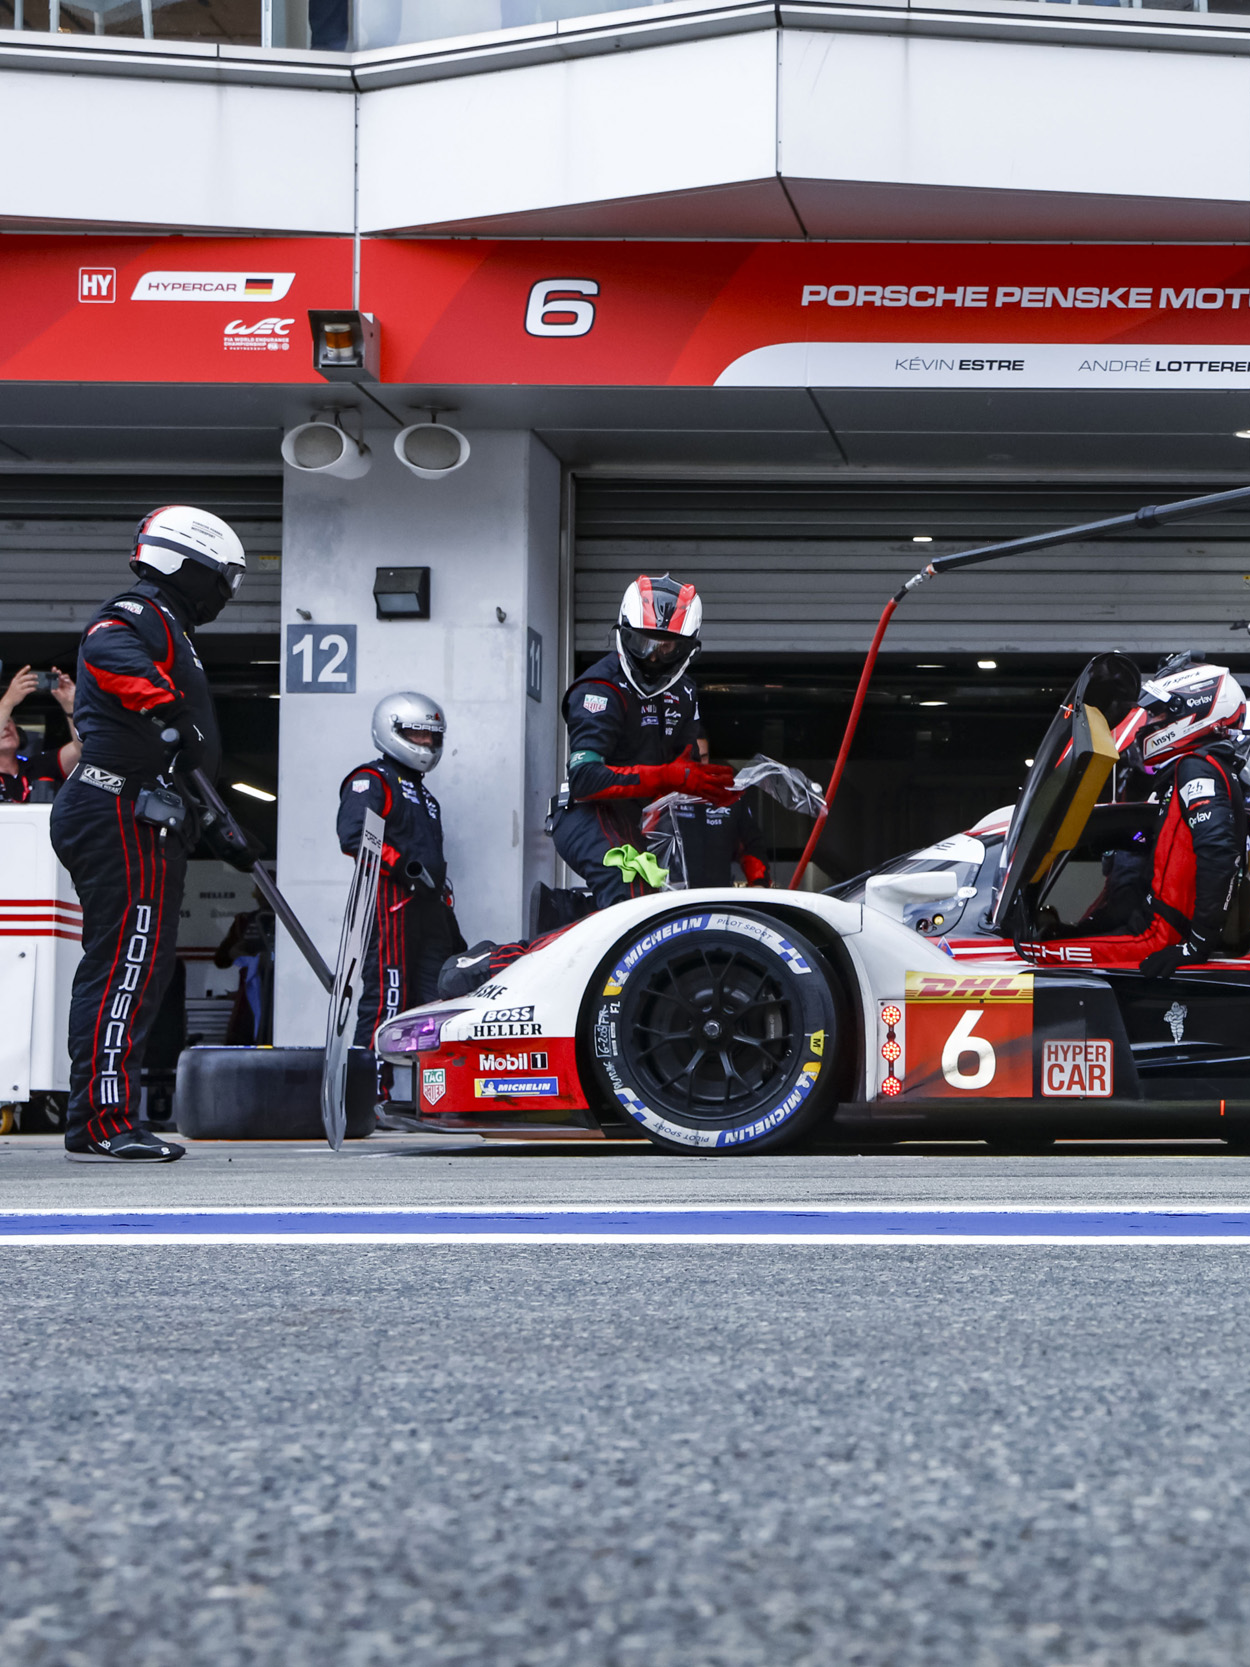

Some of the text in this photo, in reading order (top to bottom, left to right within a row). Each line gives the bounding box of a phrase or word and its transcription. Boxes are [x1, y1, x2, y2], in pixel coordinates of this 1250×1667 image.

[82, 274, 112, 296] HY
[148, 282, 237, 292] HYPERCAR
[801, 285, 989, 307] PORSCHE
[995, 286, 1153, 309] PENSKE
[525, 278, 601, 338] 6
[224, 317, 295, 335] WEC
[895, 357, 1025, 371] KÉVIN ESTRE
[1078, 358, 1151, 372] ANDRÉ
[292, 634, 348, 683] 12
[530, 640, 540, 691] 11
[402, 722, 446, 733] PORSC
[1152, 730, 1176, 748] Ansys
[717, 918, 773, 940] PILOT SPORT
[623, 916, 704, 969] MICHELIN
[918, 978, 1020, 997] DHL
[100, 904, 151, 1105] PORSCHE
[485, 1007, 531, 1022] BOSS
[474, 1024, 542, 1037] HELLER
[941, 1010, 996, 1090] 6
[1047, 1045, 1107, 1062] HYPER
[479, 1053, 528, 1071] Mobil
[424, 1071, 443, 1083] TAG
[1047, 1064, 1107, 1091] CAR
[423, 1084, 445, 1103] HEUER
[498, 1082, 551, 1092] MICHELIN
[724, 1088, 804, 1143] MICHELIN
[653, 1122, 710, 1144] PILOT SPORT
